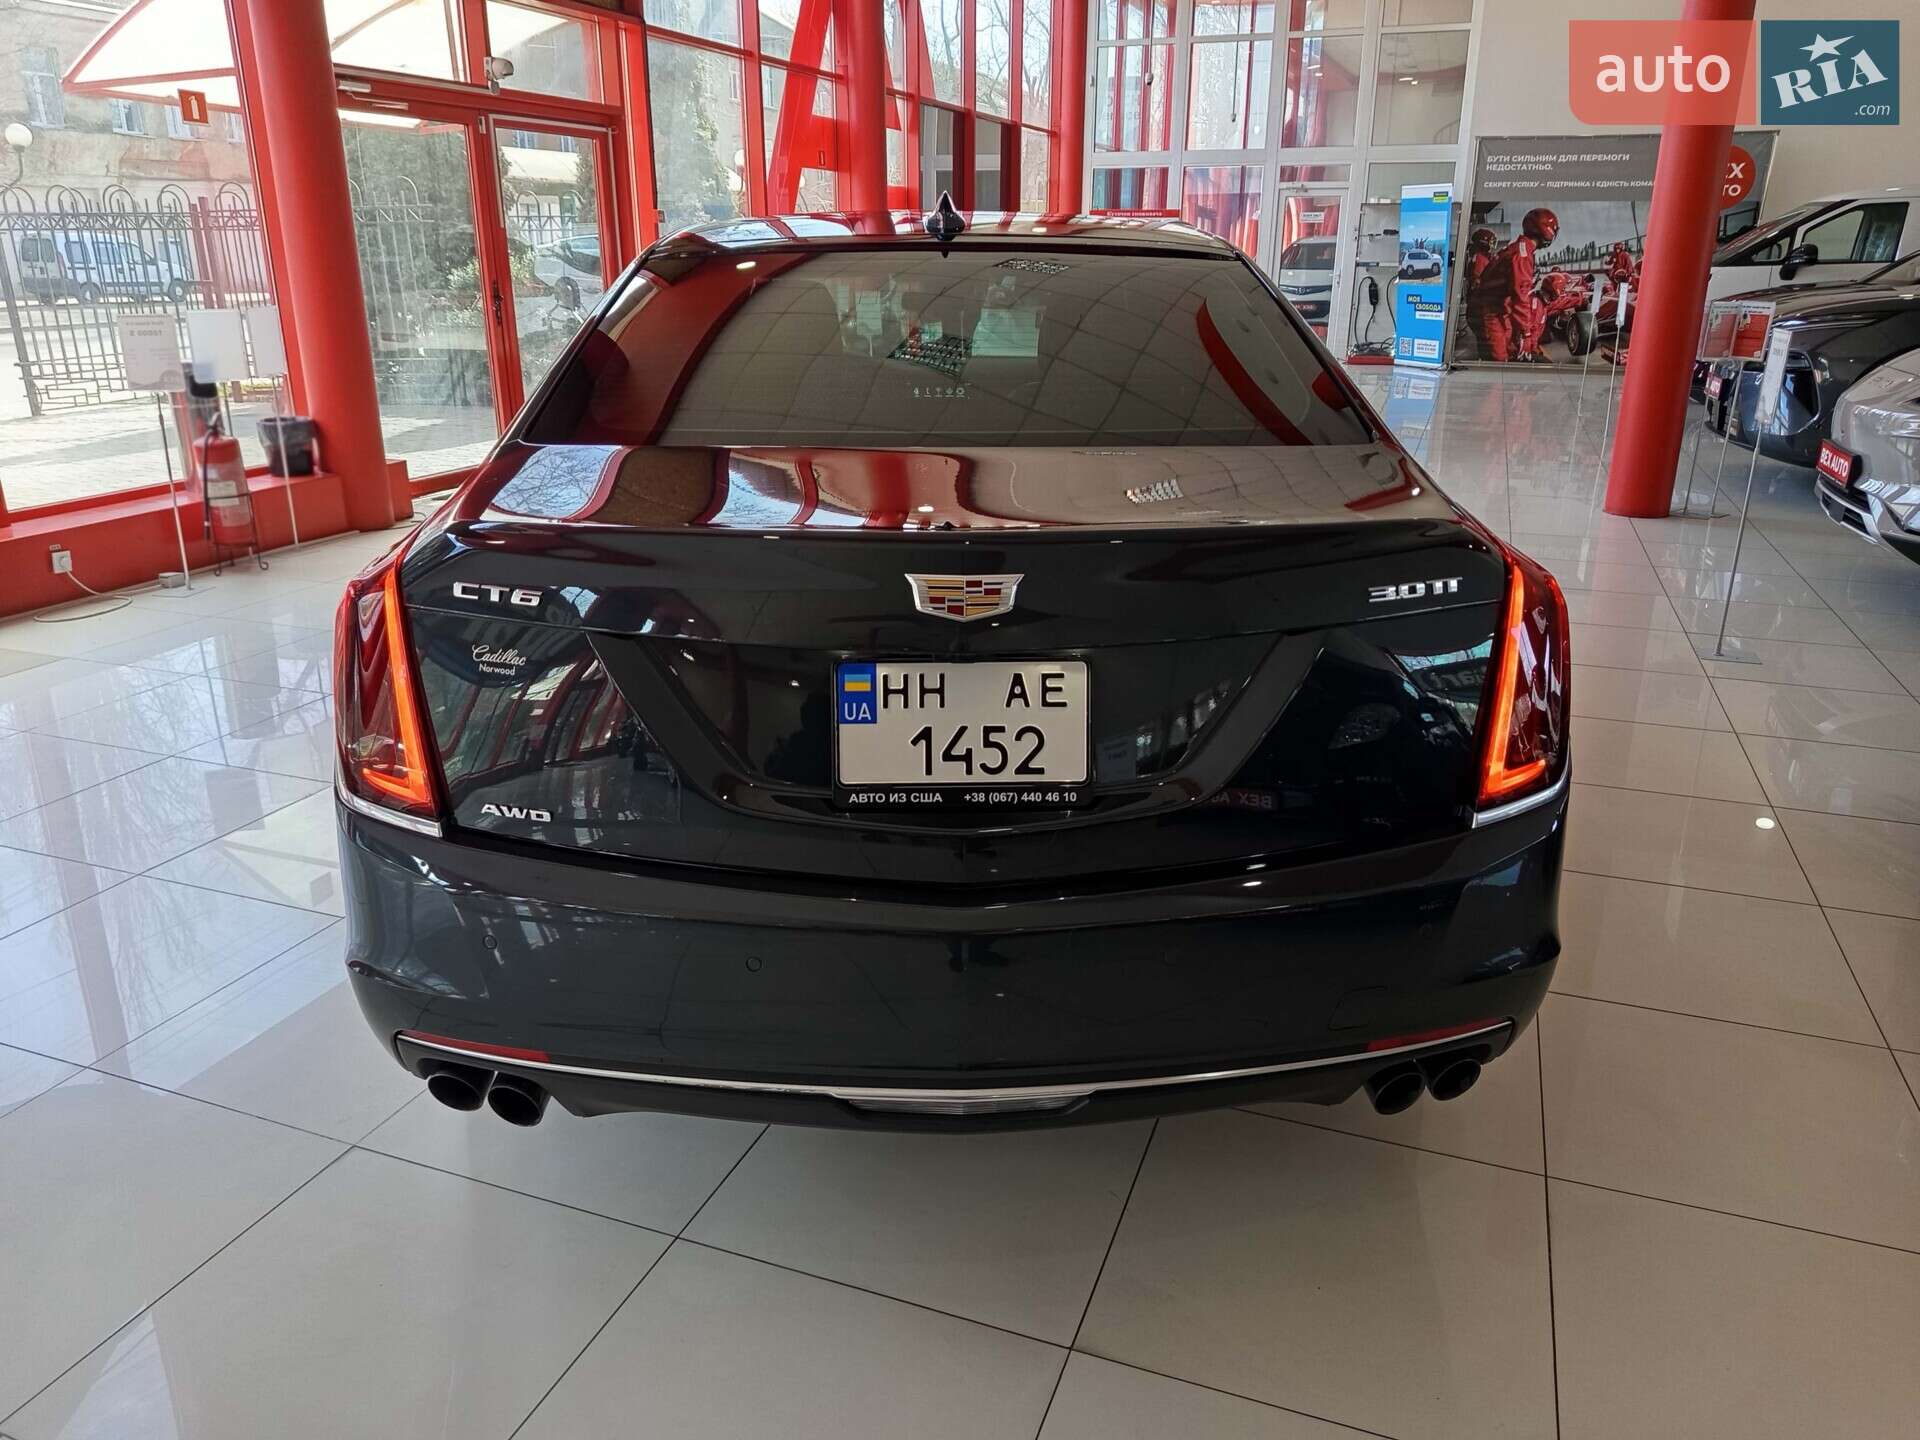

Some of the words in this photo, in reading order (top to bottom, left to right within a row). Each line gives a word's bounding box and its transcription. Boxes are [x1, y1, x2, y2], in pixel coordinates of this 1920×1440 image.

[1486, 154, 1511, 162] БУТИ
[1512, 153, 1557, 162] СИЛЬНИМ
[1558, 153, 1578, 163] ДЛЯ
[1580, 153, 1631, 161] ПЕРЕМОГИ
[1486, 163, 1553, 171] НЕДОСТАТНЬО.
[1830, 454, 1849, 478] AUTO
[453, 581, 543, 607] CT6
[472, 645, 527, 666] Cadillac
[478, 663, 516, 676] Norwood
[844, 703, 872, 720] UA
[910, 725, 1046, 776] 1452
[849, 792, 886, 803] АВТО
[889, 792, 907, 803] ИЗ
[910, 792, 943, 803] США
[964, 792, 986, 802] +38
[989, 792, 1018, 804] (067)
[1021, 792, 1042, 802] 440
[1045, 792, 1060, 802] 46
[1063, 792, 1077, 802] 10
[480, 803, 552, 823] AWD
